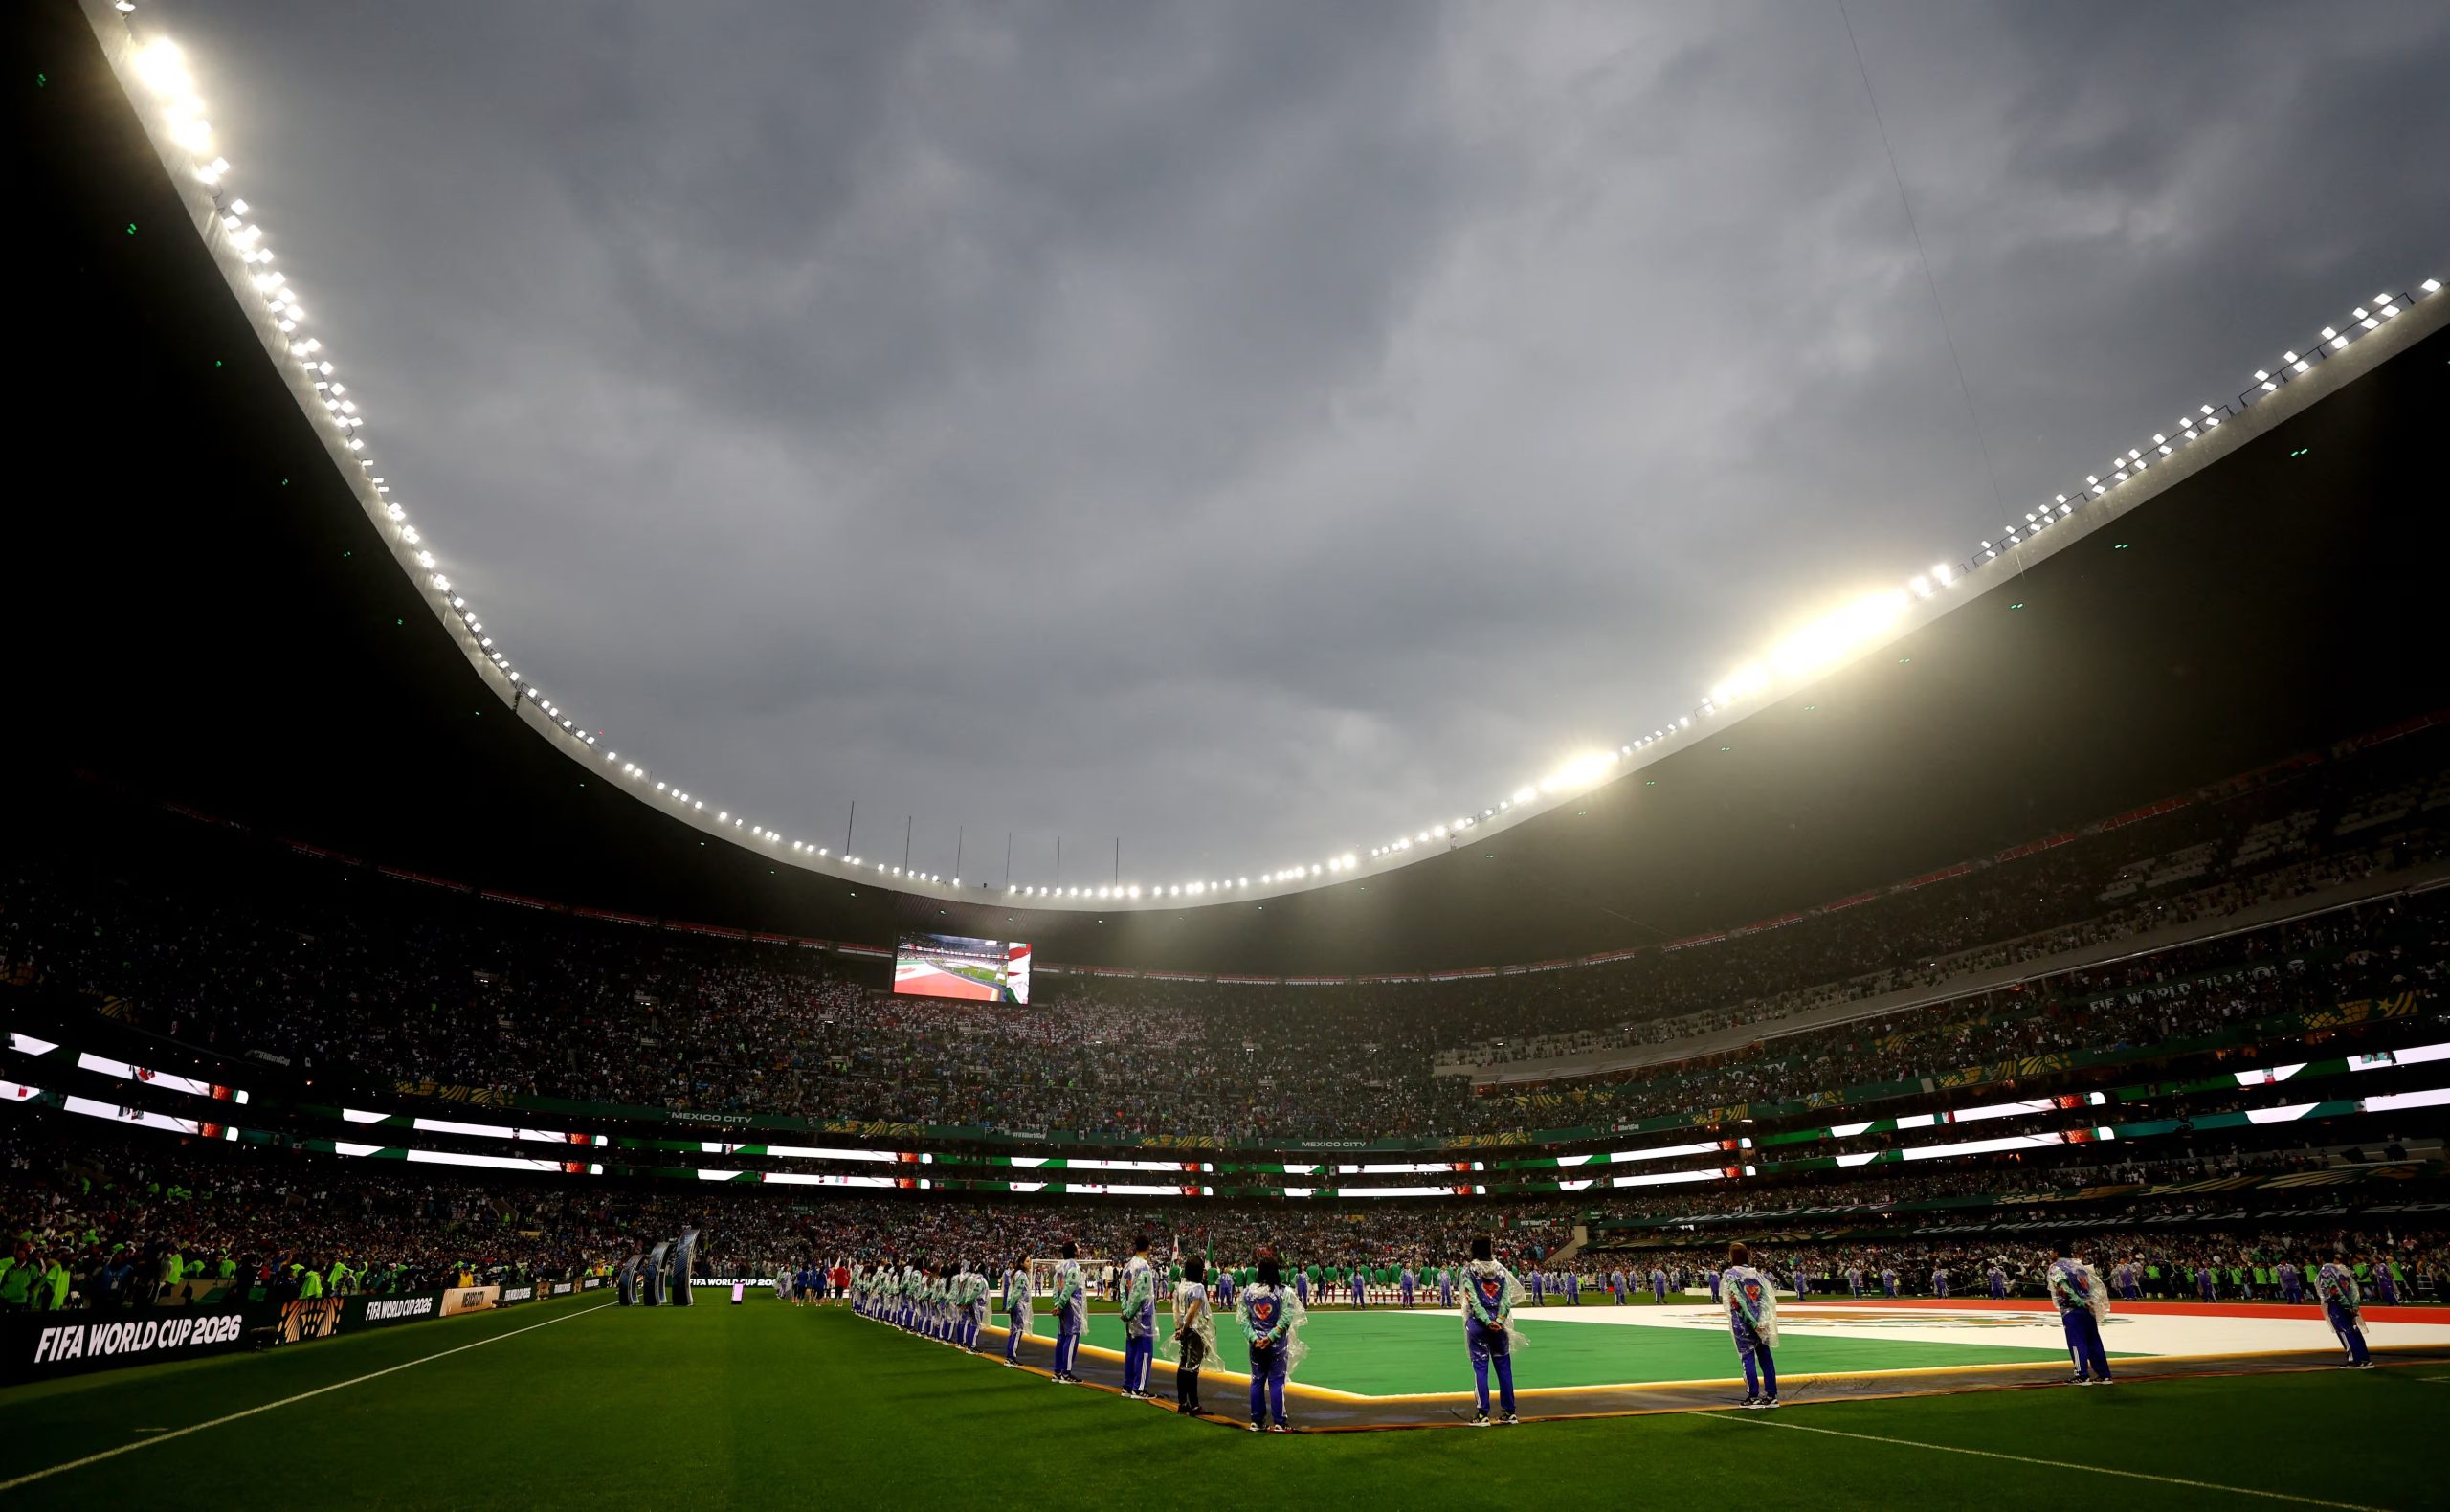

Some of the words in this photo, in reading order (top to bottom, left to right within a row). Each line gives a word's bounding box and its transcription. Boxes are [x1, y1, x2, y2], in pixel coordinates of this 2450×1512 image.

[671, 1112, 722, 1122] MEXICO
[723, 1115, 753, 1123] CITY
[1667, 1210, 1797, 1223] MEXICO
[1913, 1225, 1988, 1234] COPA
[1991, 1216, 2136, 1231] MUNDIAL
[2143, 1214, 2197, 1223] DE
[2196, 1212, 2248, 1221] LA
[689, 1278, 706, 1286] FIFA
[742, 1278, 757, 1286] CUP
[365, 1301, 381, 1321] FIFA
[380, 1300, 404, 1319] WORLD
[402, 1299, 415, 1316] CUP
[413, 1297, 433, 1315] 2026
[33, 1325, 85, 1364] FIFA
[87, 1320, 158, 1357] WORLD
[157, 1318, 192, 1349] CUP
[190, 1314, 242, 1345] 2026
